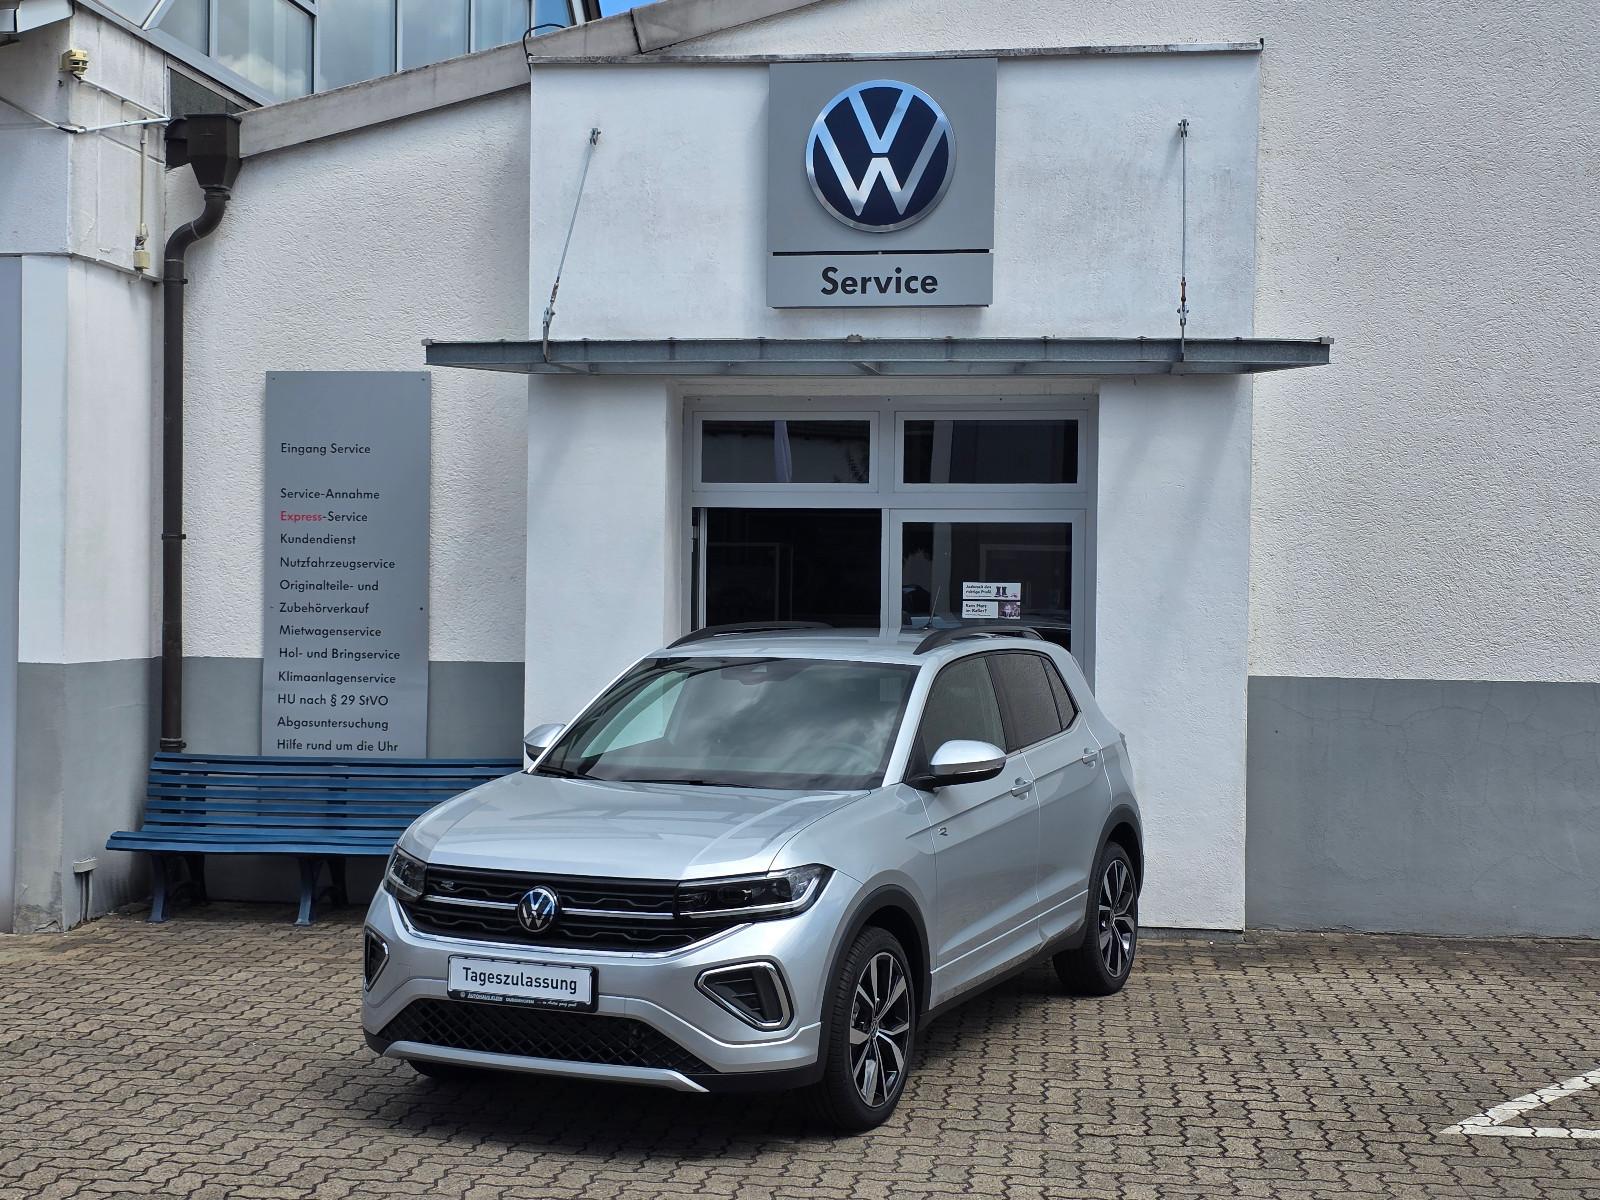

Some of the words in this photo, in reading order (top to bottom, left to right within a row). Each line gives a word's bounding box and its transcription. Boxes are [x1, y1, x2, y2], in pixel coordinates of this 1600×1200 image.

[820, 266, 939, 296] Service
[280, 442, 327, 456] Eingang
[330, 442, 371, 454] Service
[280, 487, 380, 500] Service-Annahme
[280, 510, 368, 523] Express-Service
[280, 533, 356, 545] Kundendienst
[280, 556, 396, 571] Nutzfahrzeugservice
[279, 579, 354, 593] Originalteile-
[357, 580, 379, 592] und
[279, 602, 370, 614] Zubehörverkauf
[279, 624, 382, 638] Mietwagenservice
[279, 647, 303, 659] Hol-
[306, 648, 328, 659] und
[331, 648, 400, 662] Bringservice
[278, 670, 397, 685] Klimaanlagenservice
[277, 693, 296, 705] HU
[299, 693, 327, 705] nach
[330, 693, 337, 707] §
[340, 694, 356, 706] 29
[359, 695, 389, 706] StVO
[277, 715, 389, 731] Abgasuntersuchung
[277, 738, 303, 750] Hilfe
[306, 739, 332, 751] rund
[335, 742, 353, 751] um
[356, 740, 374, 751] die
[377, 741, 398, 752] Uhr
[462, 966, 577, 995] Tageszulassung
